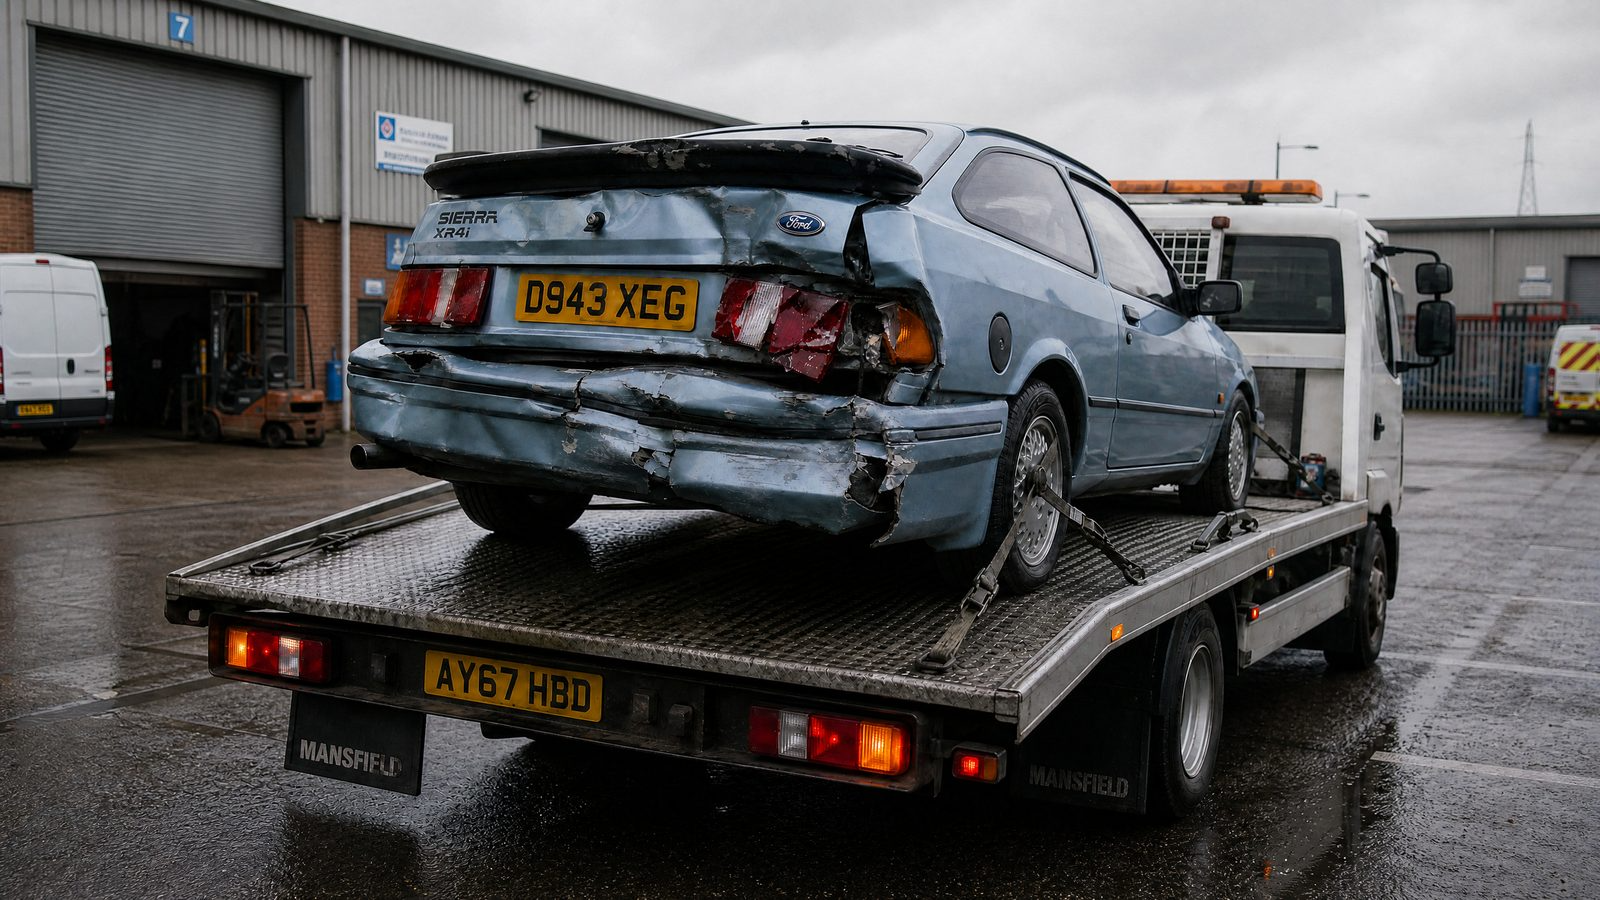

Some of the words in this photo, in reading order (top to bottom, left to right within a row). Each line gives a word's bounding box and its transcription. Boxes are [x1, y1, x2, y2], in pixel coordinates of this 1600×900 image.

[175, 15, 190, 39] 7
[438, 210, 498, 225] SIERRA
[786, 215, 813, 230] Ford
[433, 227, 471, 239] XR4i
[524, 279, 608, 317] D943
[615, 283, 686, 321] XEG
[436, 657, 519, 701] AY67
[528, 671, 591, 713] HBD
[299, 738, 402, 778] MANSFIELD
[1029, 764, 1129, 798] MANSFIELD
